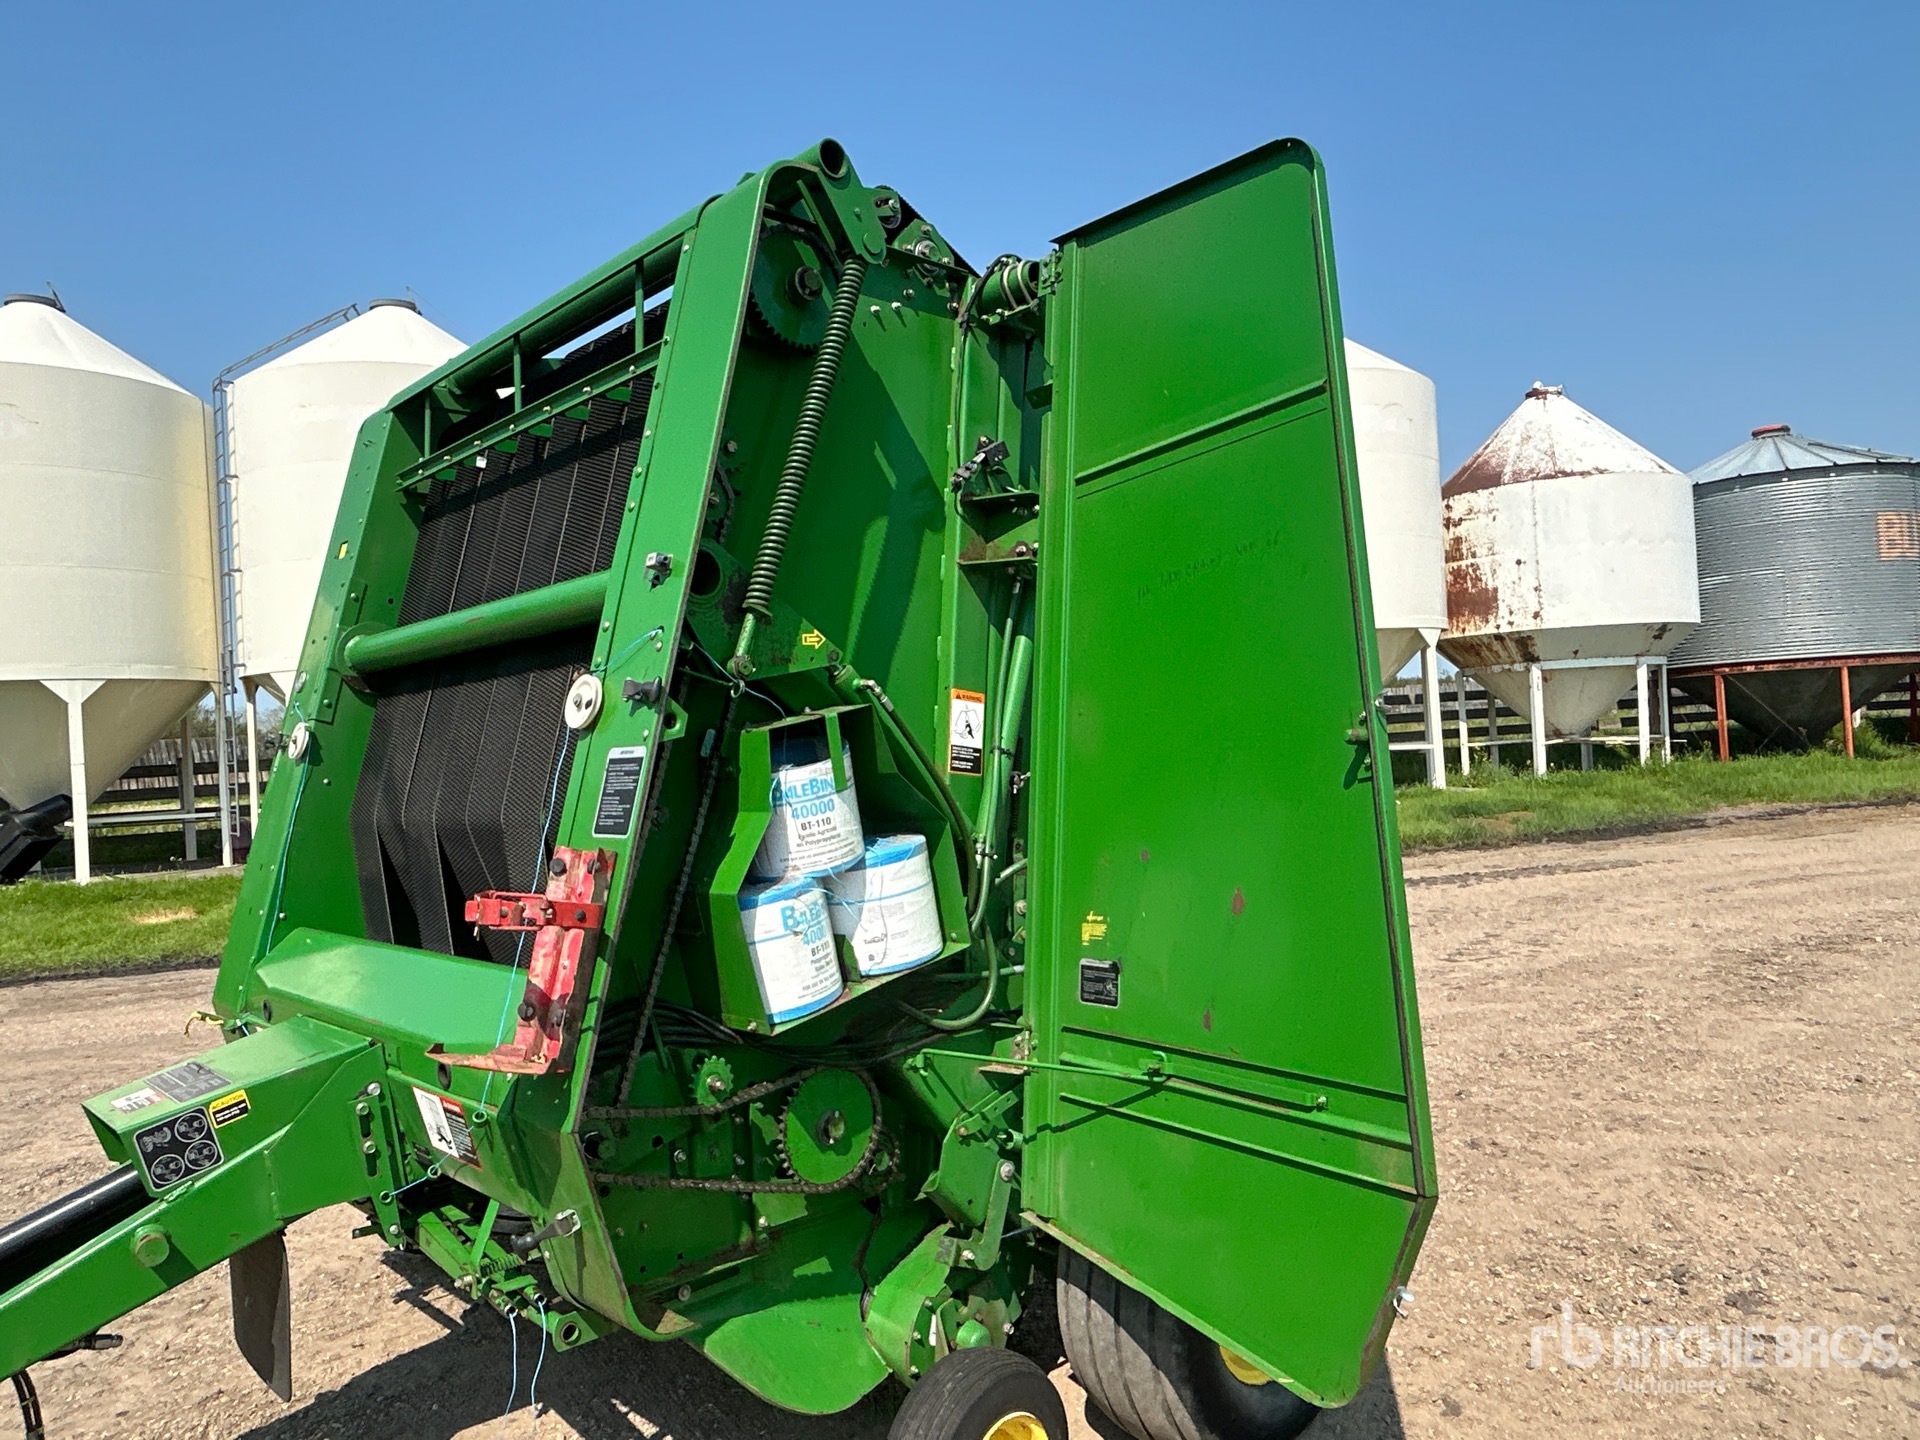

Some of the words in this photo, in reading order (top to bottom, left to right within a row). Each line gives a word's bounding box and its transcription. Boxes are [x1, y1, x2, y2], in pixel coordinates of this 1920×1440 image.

[791, 797, 836, 821] 40000
[800, 816, 832, 832] BT-110
[218, 1092, 245, 1107] CAUTION
